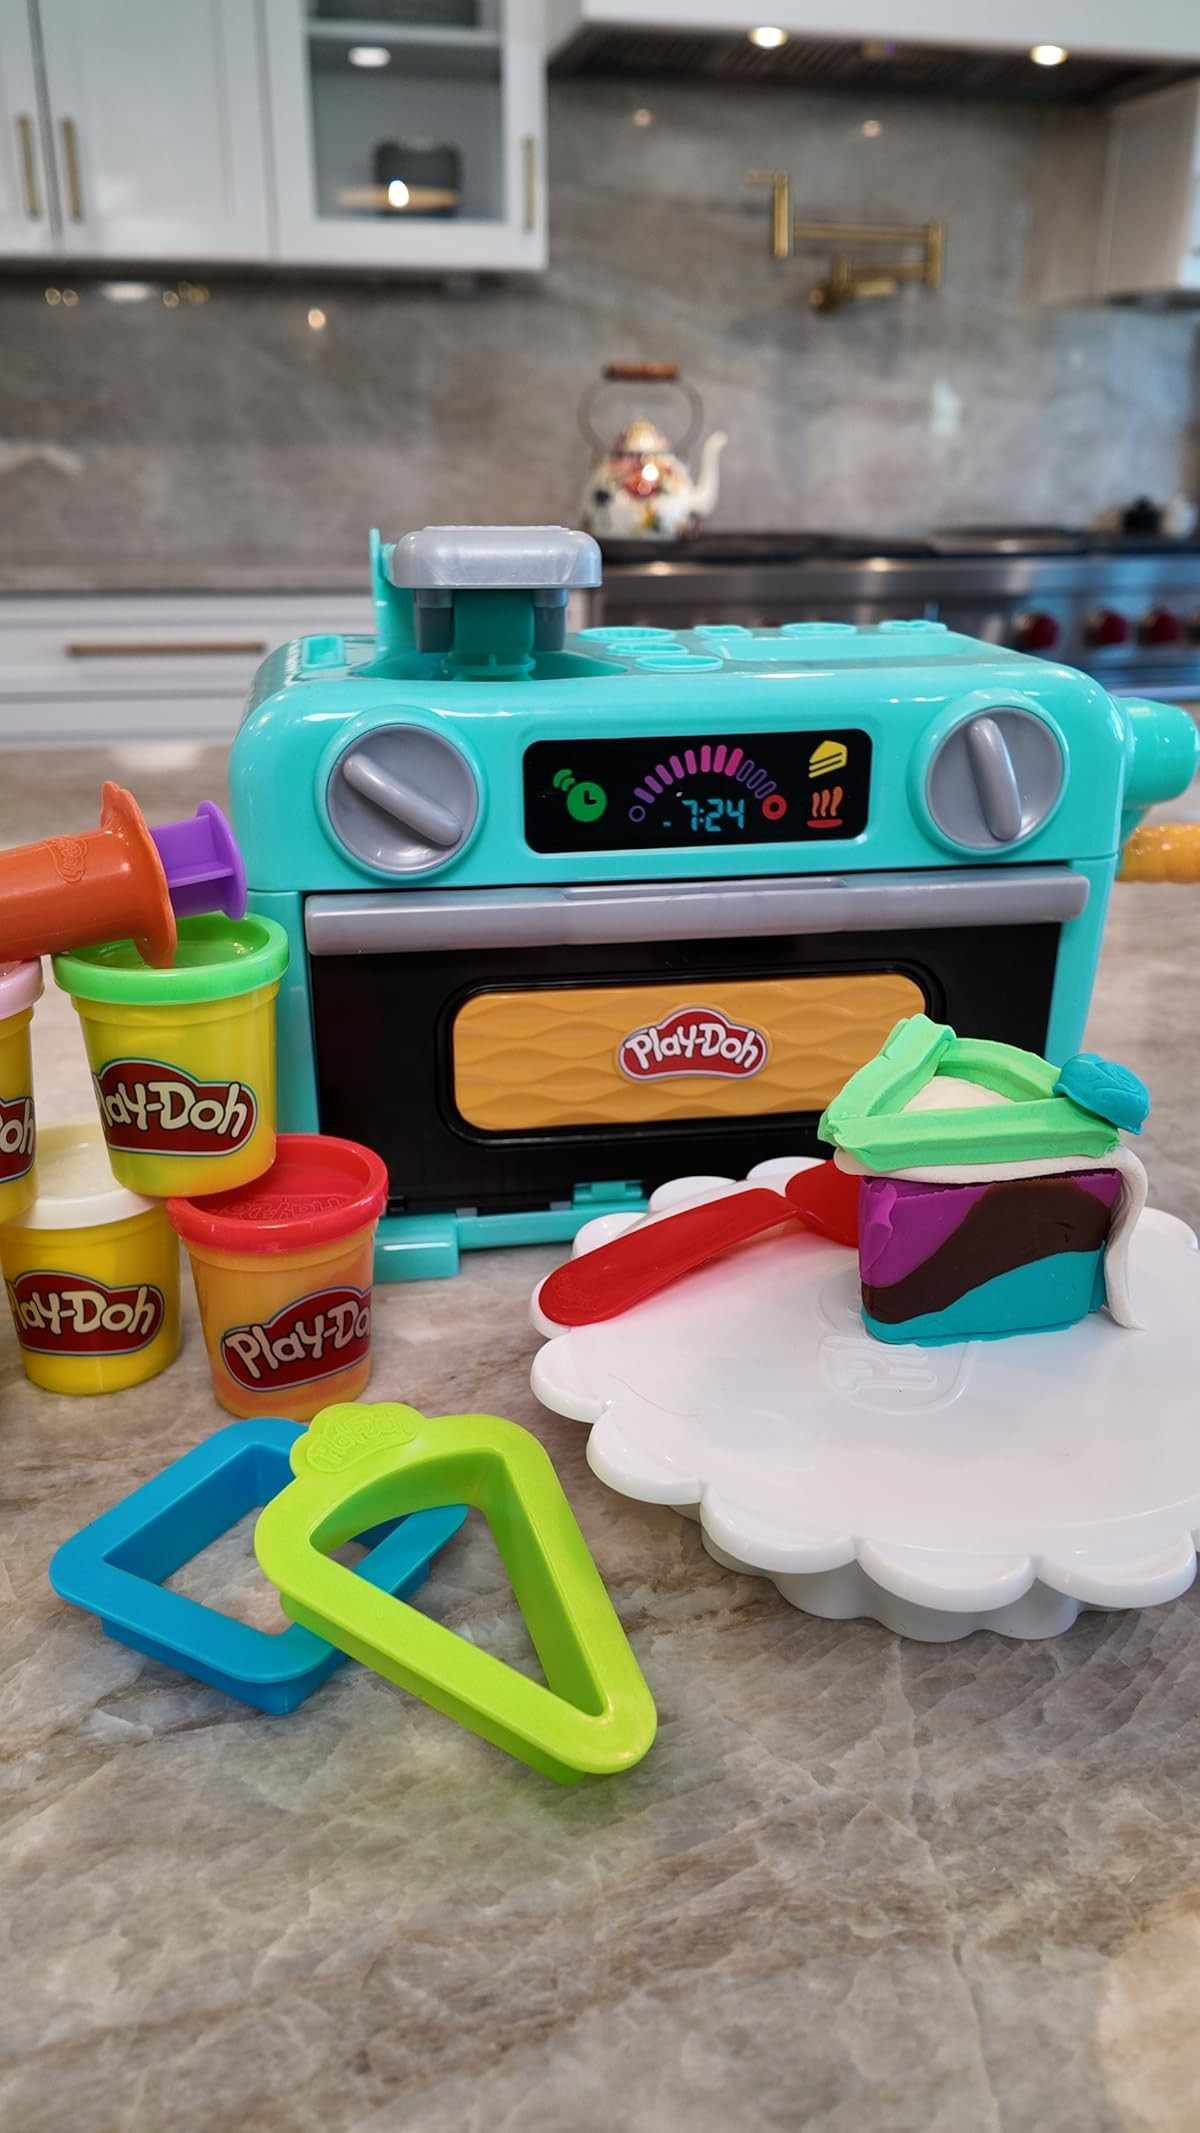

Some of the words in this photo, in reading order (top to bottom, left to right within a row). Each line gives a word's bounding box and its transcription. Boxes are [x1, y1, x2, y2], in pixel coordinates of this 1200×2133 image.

[681, 799, 745, 832] 7:24
[623, 1022, 759, 1071] Play-Doh
[94, 1074, 249, 1139] lay-Doh
[7, 1282, 156, 1335] lay-Doh
[224, 1300, 371, 1379] Play-Do
